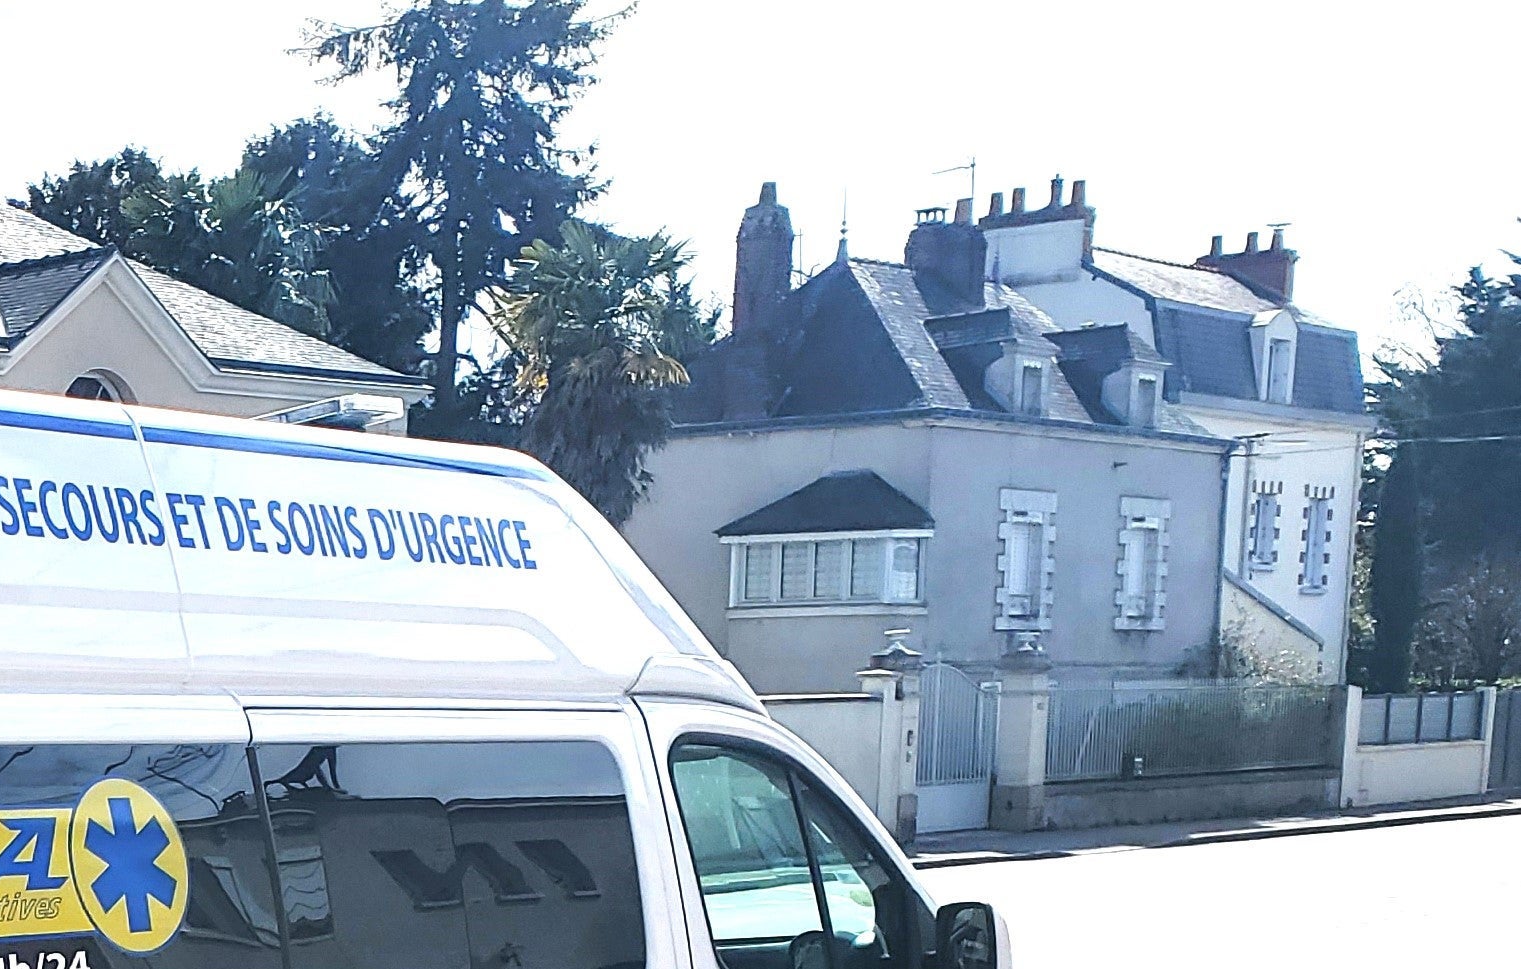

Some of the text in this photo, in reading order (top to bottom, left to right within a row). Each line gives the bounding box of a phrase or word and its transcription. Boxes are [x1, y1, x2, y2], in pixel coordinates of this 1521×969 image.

[165, 492, 211, 550] ET
[214, 496, 268, 553] DE
[267, 500, 368, 560] SOINS
[367, 508, 537, 570] D'URGENCE
